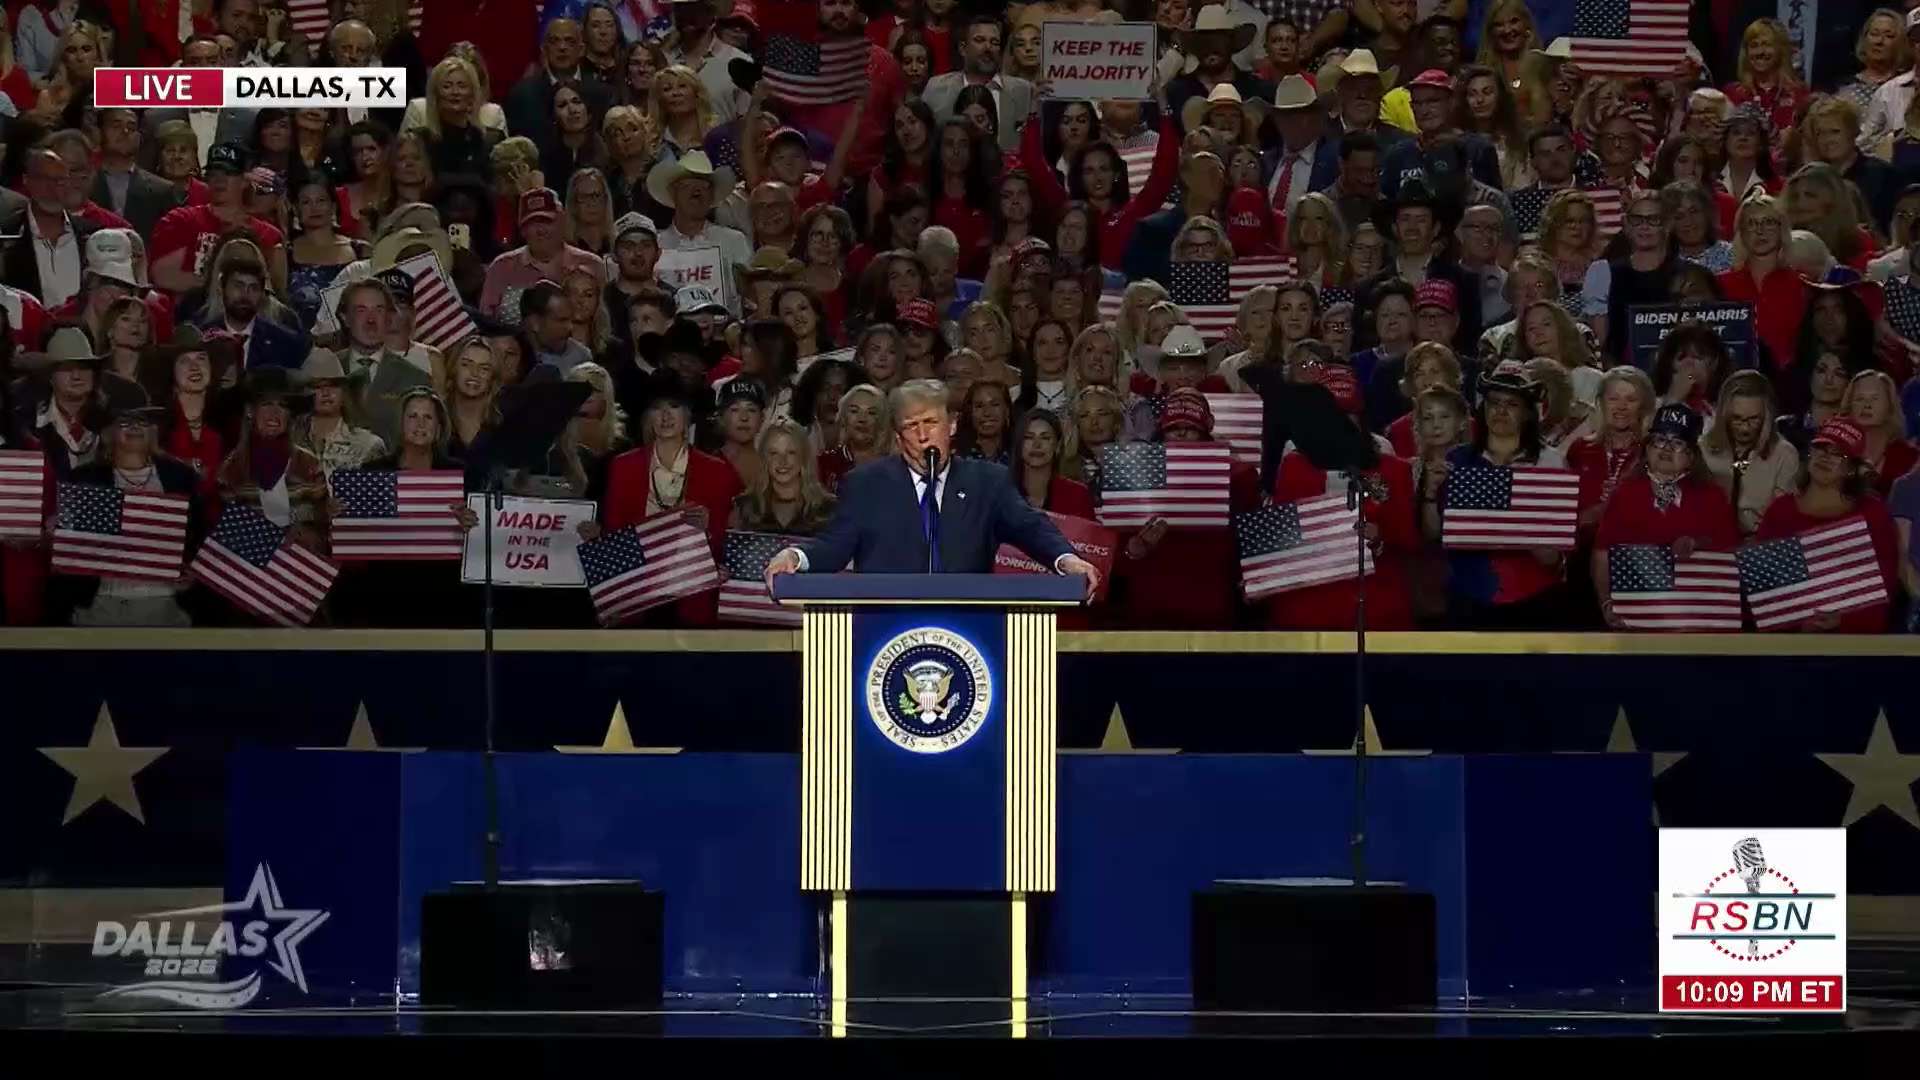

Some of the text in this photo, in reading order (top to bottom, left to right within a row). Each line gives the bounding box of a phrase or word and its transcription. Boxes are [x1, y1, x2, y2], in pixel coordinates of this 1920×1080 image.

[1052, 40, 1147, 56] KEEP THE
[1047, 64, 1150, 80] MAJORITY
[674, 265, 713, 283] THE
[1635, 312, 1678, 325] BIDEN
[1696, 308, 1750, 322] HARRIS
[1661, 409, 1688, 427] USA
[497, 511, 567, 531] MADE
[507, 535, 552, 548] IN THE
[504, 552, 549, 570] USA
[932, 634, 944, 642] OF
[946, 638, 962, 651] THE
[871, 632, 928, 687] PRESIDENT
[964, 649, 988, 702] UNITED
[886, 721, 917, 747] SEAL
[941, 710, 983, 747] STATES
